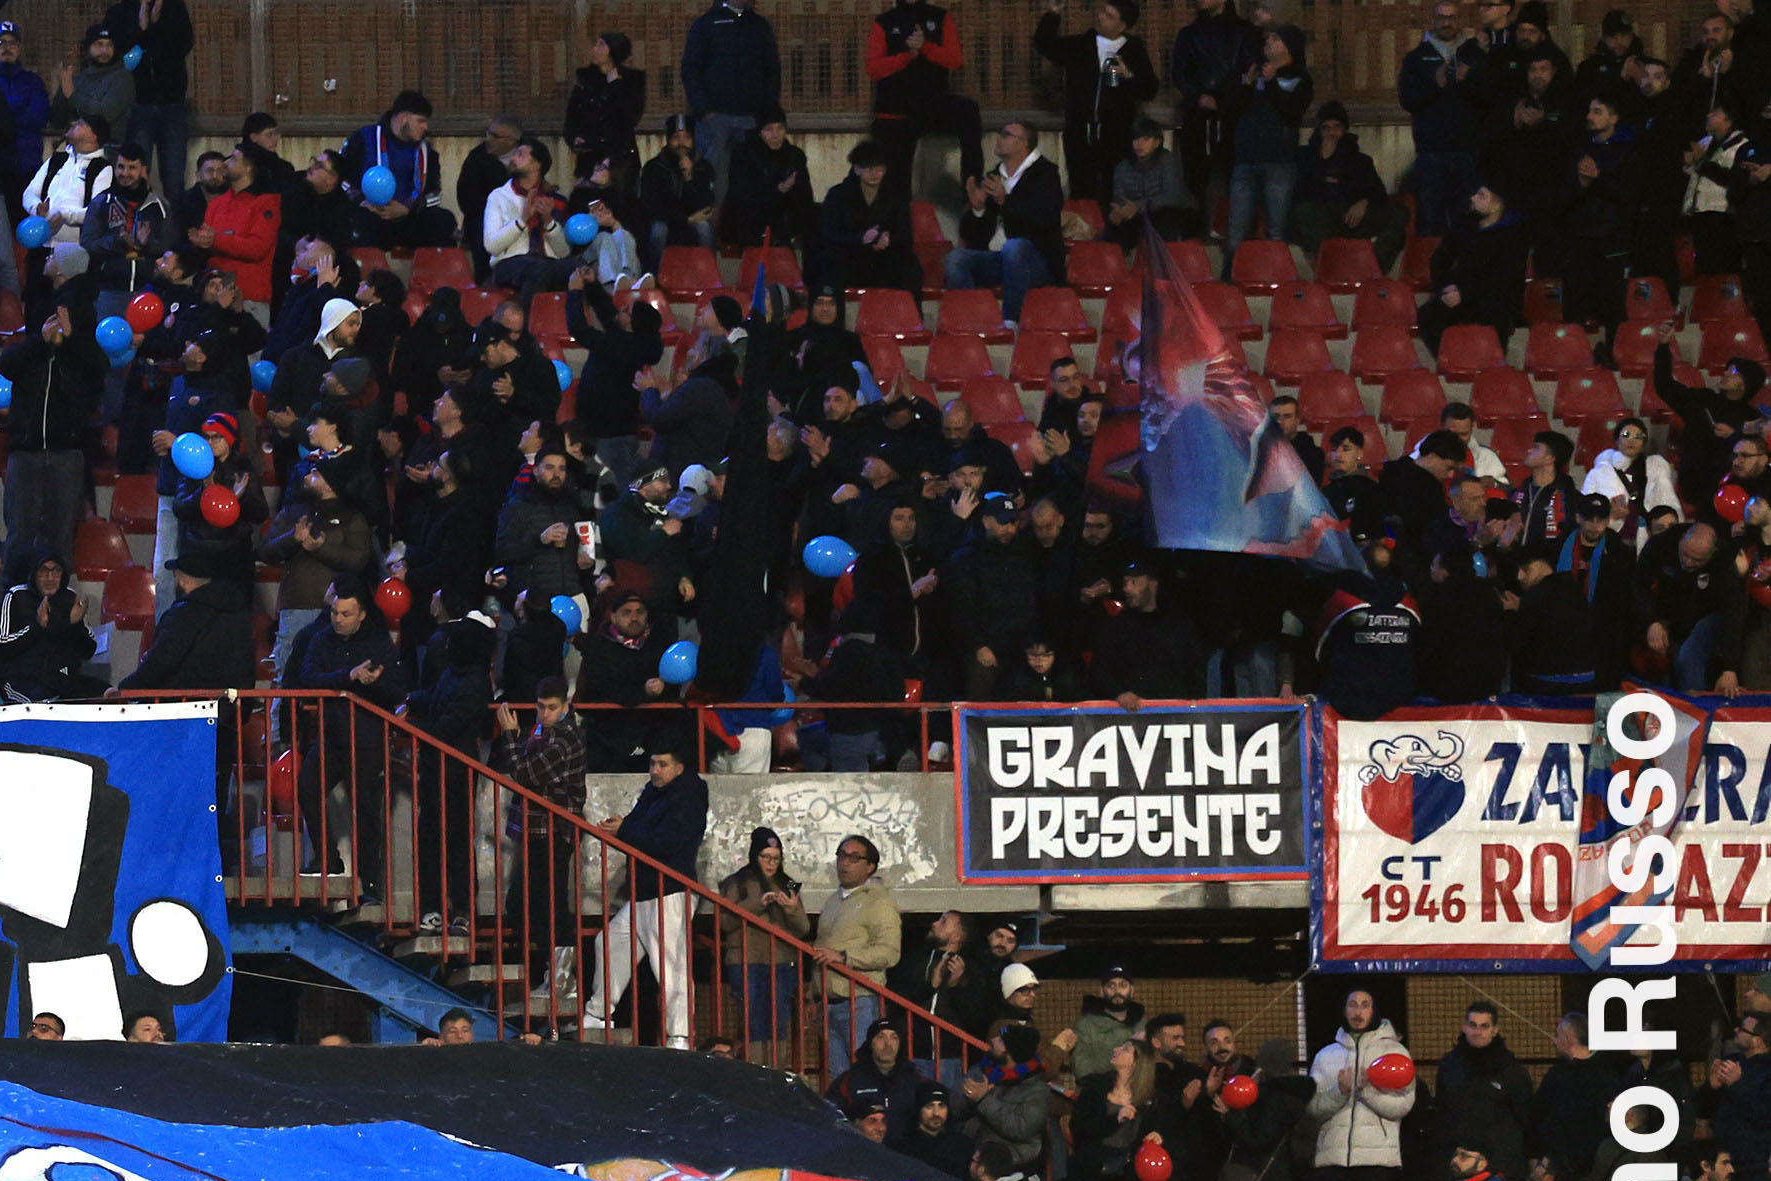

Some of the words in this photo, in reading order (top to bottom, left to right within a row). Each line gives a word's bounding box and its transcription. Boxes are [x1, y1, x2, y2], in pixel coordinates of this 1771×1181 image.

[986, 721, 1281, 790] GRAVINA
[990, 792, 1281, 861] PRESENTE
[1380, 855, 1442, 882] CT
[1361, 884, 1467, 925] 1946
